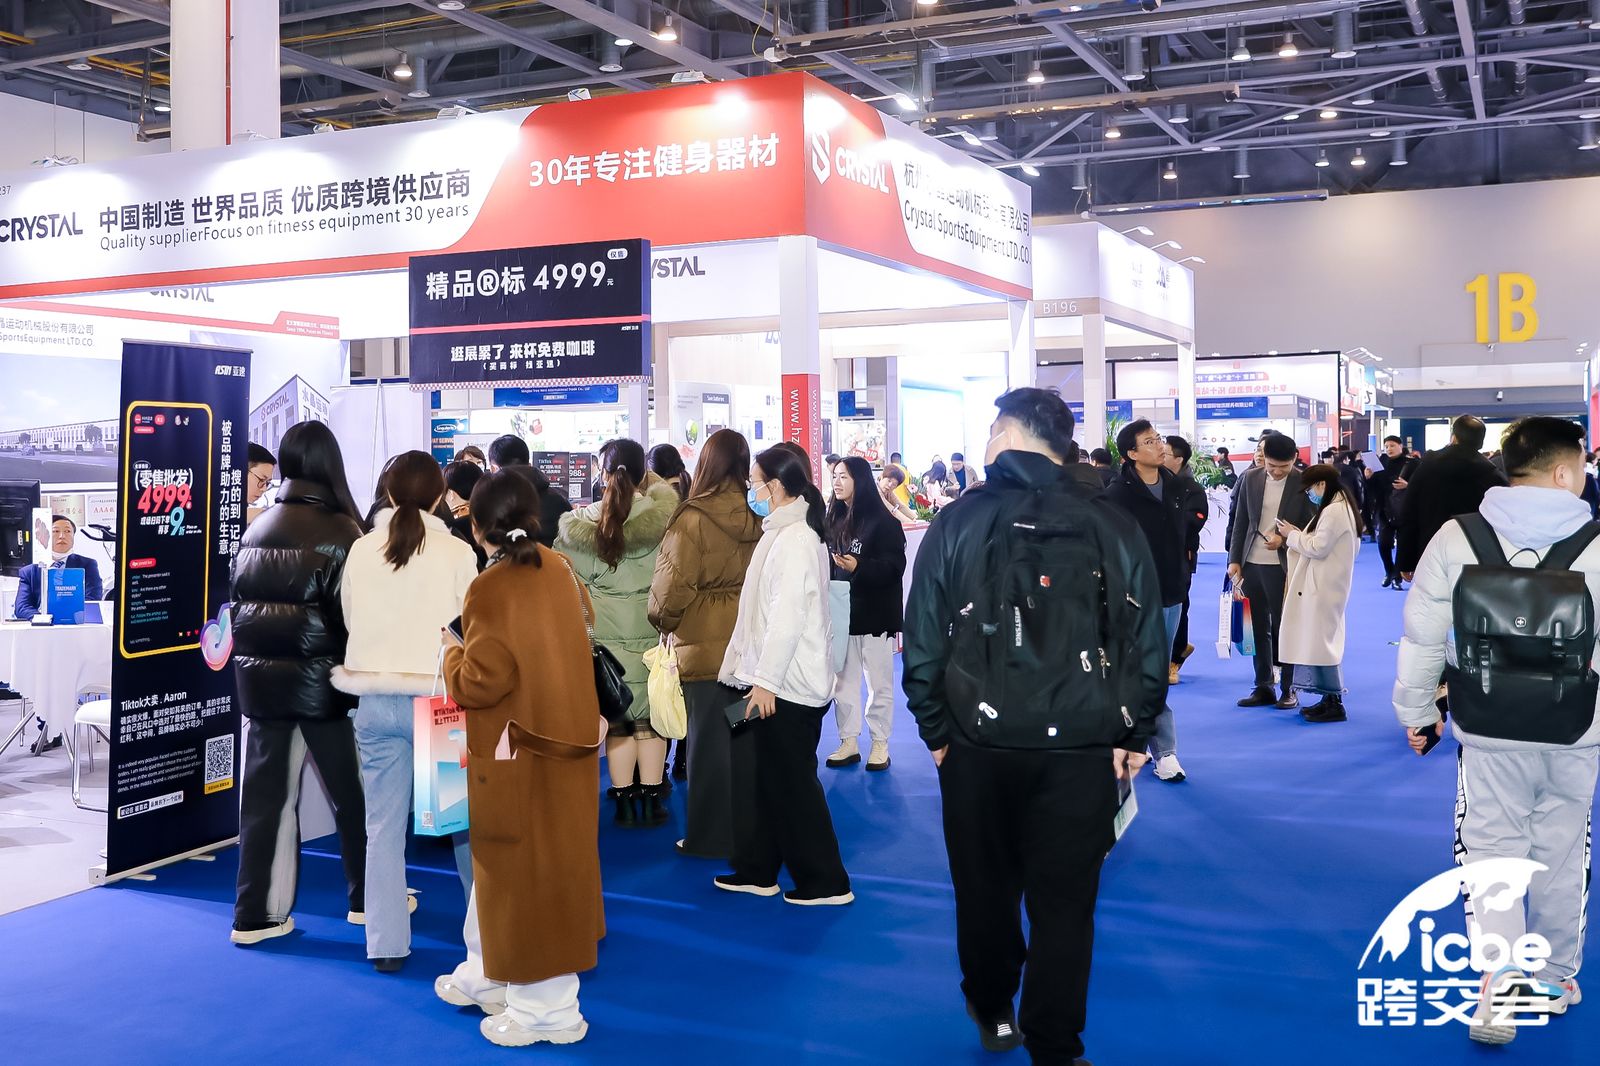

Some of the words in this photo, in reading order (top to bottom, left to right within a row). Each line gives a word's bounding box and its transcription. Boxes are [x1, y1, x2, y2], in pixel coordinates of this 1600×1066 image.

[529, 133, 780, 187] 30年专注健身器材
[835, 145, 890, 194] CRYSTAL
[99, 199, 185, 233] 中国制造
[192, 188, 283, 223] 世界品质
[291, 168, 470, 214] 优质跨境供应商
[904, 200, 936, 230] Crystal
[0, 212, 83, 243] CRYSTAL
[100, 233, 146, 251] Quality
[149, 225, 242, 248] supplierFocus
[246, 224, 263, 237] on
[268, 218, 315, 235] fitness
[319, 209, 401, 233] equipment
[405, 205, 423, 222] 30
[427, 203, 469, 224] years
[1043, 301, 1077, 313] B196
[1465, 273, 1538, 343] 1B
[451, 344, 505, 362] 逛展累了
[509, 340, 595, 359] 来杯免费咖啡
[266, 392, 290, 415] CRYSTAL
[135, 468, 193, 491] (零售批发)
[218, 420, 232, 555] 被品牌助力的生意
[137, 484, 190, 513] 4999
[229, 524, 240, 571] 记得
[164, 691, 187, 703] Aaron
